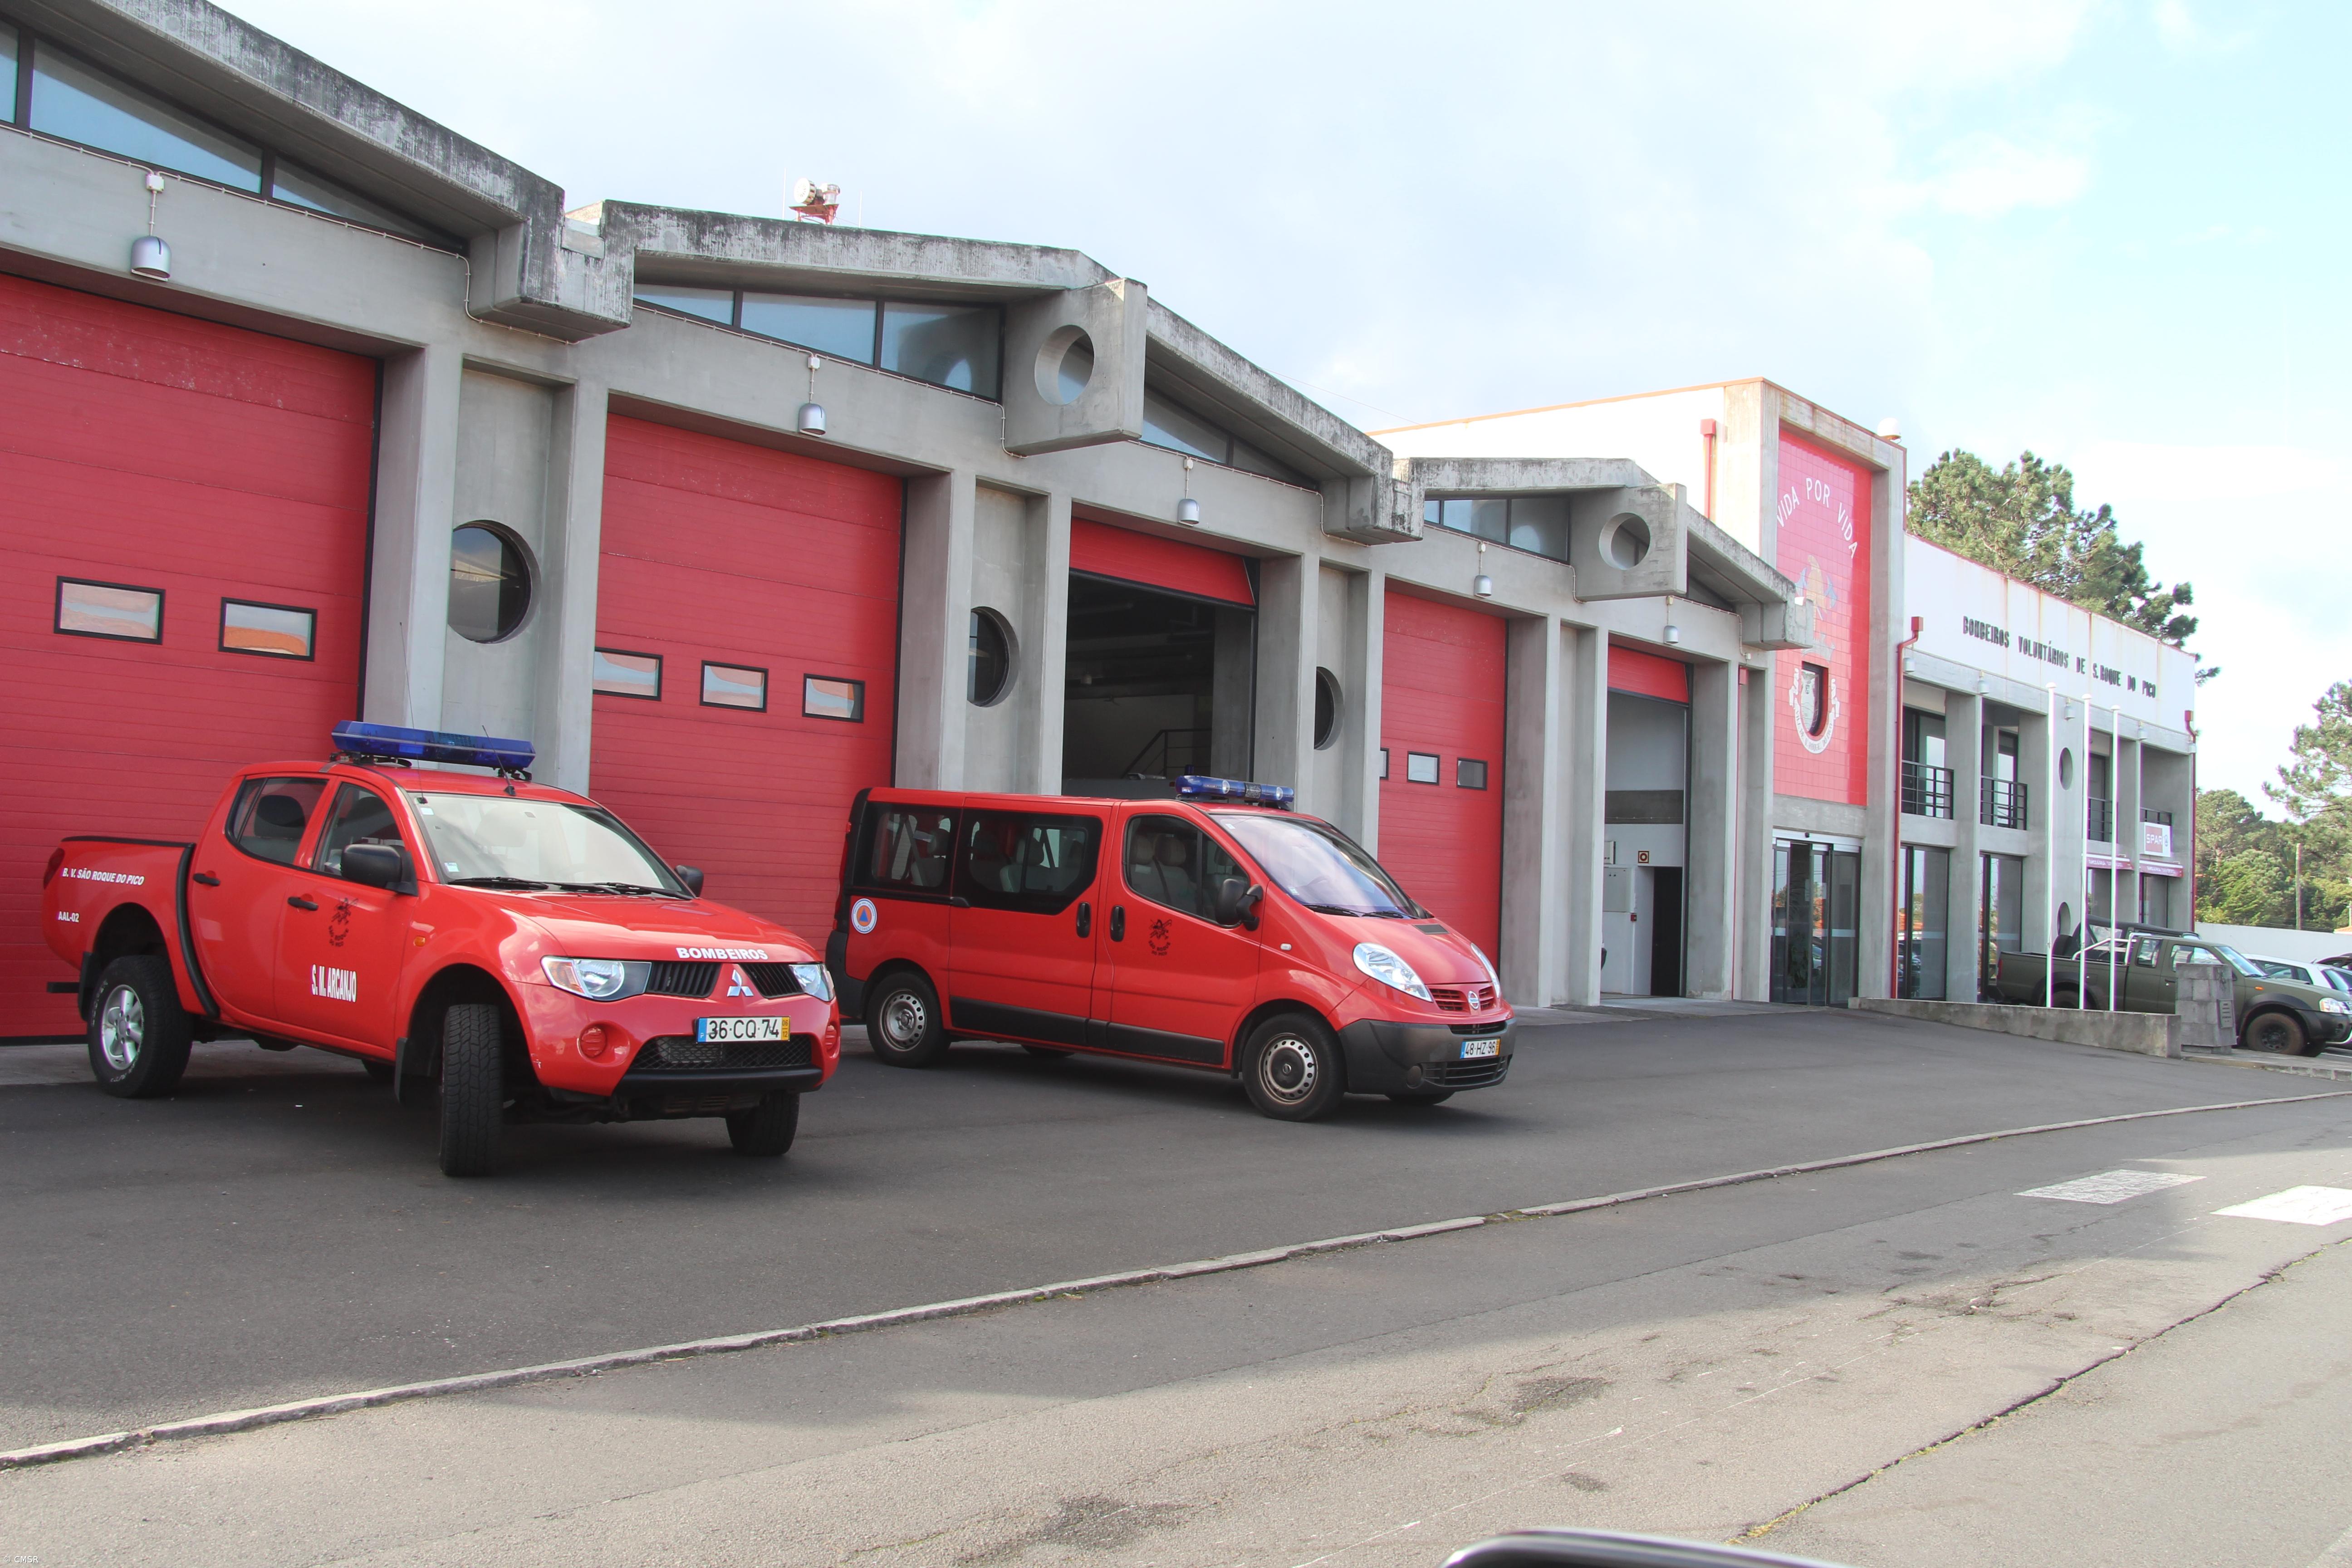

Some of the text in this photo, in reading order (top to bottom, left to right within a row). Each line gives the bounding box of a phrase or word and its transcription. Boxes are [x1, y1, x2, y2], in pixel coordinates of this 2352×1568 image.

[1777, 478, 1858, 559] VIDA POR VIDA
[1963, 615, 2009, 648] BOMBEIROS
[2018, 636, 2069, 668] VOLUNTÁRIOS
[2076, 657, 2086, 675] DE
[2127, 675, 2136, 691] DO
[2142, 680, 2156, 698] PICO
[2146, 834, 2162, 844] SPAR
[63, 867, 145, 886] B. V. SÃO ROQUE DO PICO
[58, 911, 80, 923] AAL-02
[676, 947, 769, 960] BOMBEIROS
[312, 964, 357, 1003] S. M. ARCANJO
